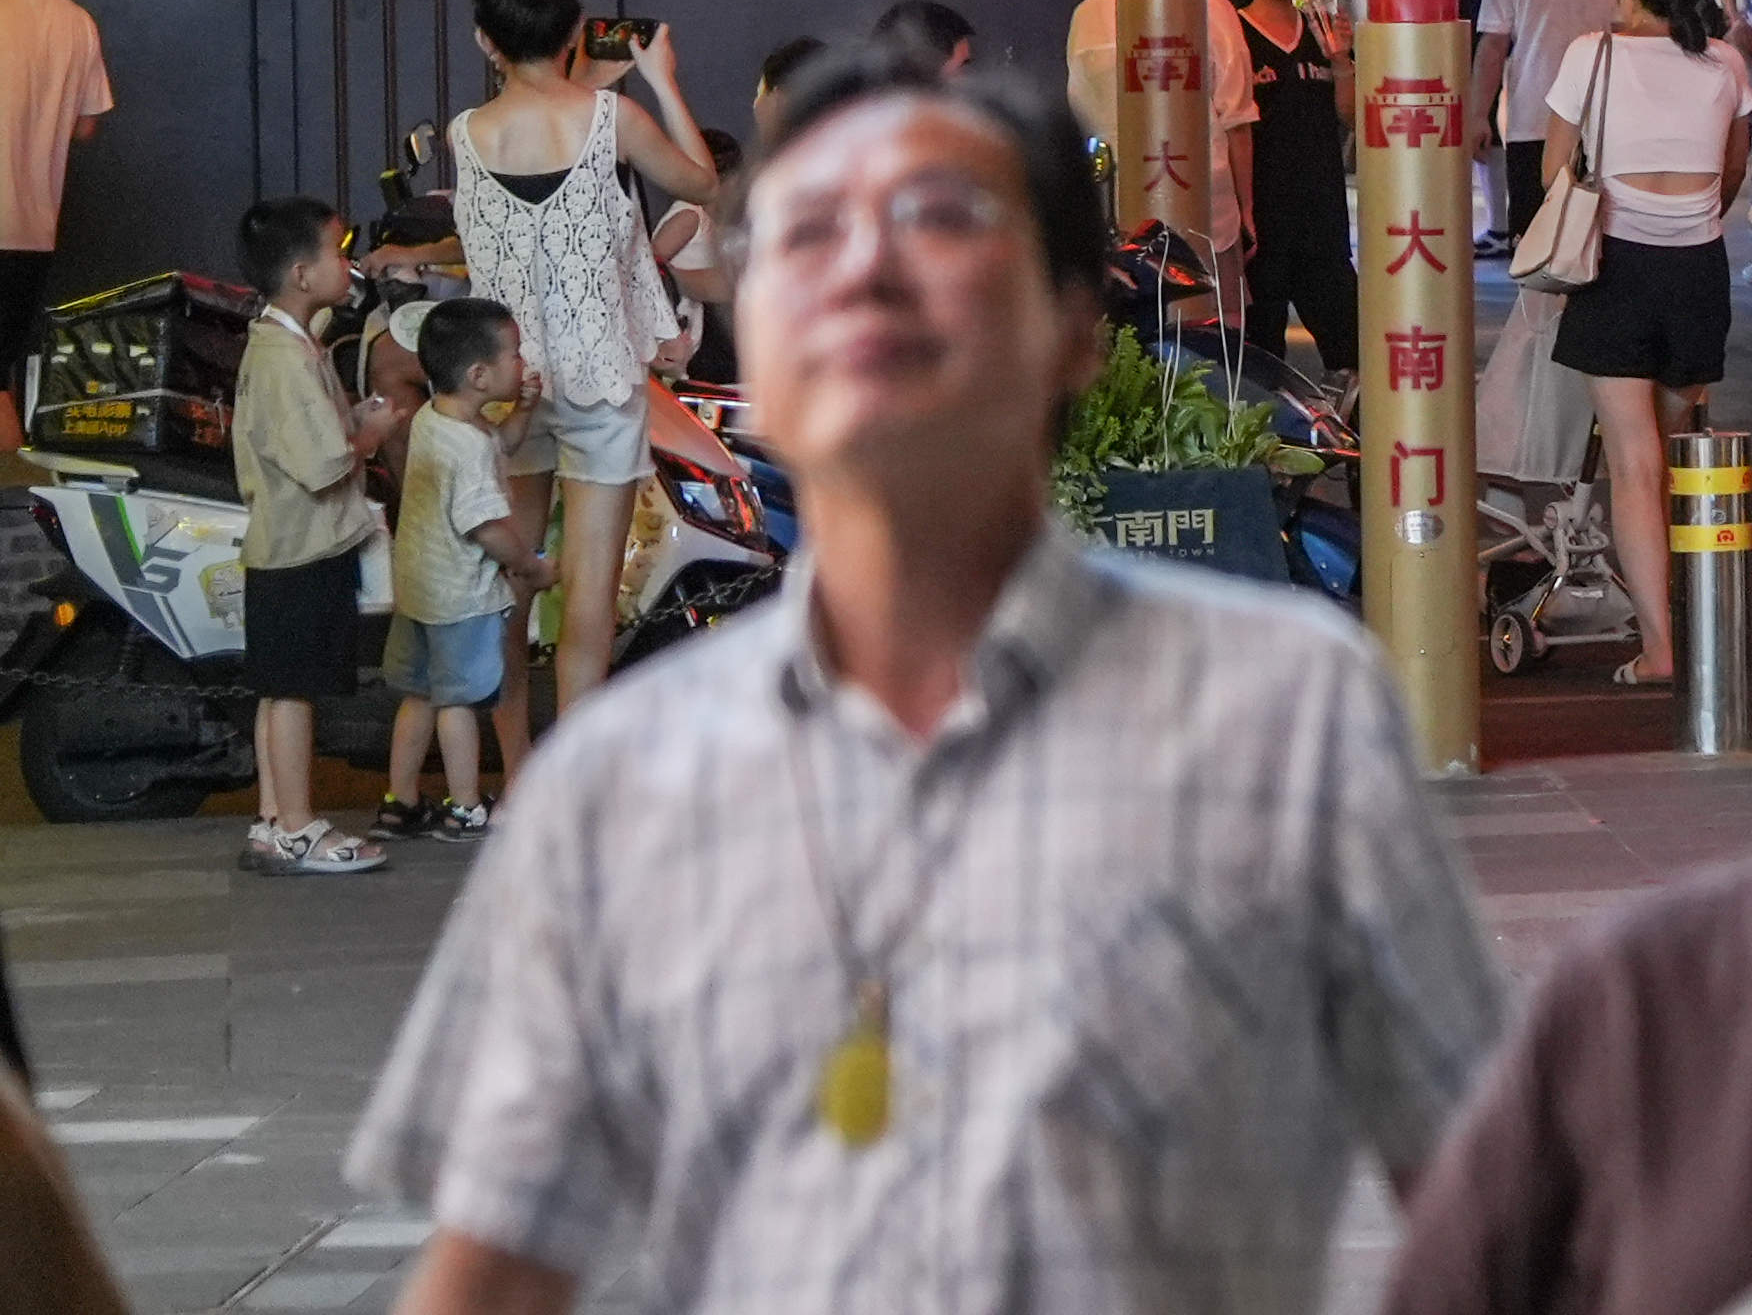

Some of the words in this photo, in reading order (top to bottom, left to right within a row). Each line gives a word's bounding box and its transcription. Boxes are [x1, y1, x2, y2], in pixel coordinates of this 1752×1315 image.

[1143, 141, 1192, 192] 大
[1384, 210, 1448, 508] 大南门
[1092, 508, 1214, 547] 南門
